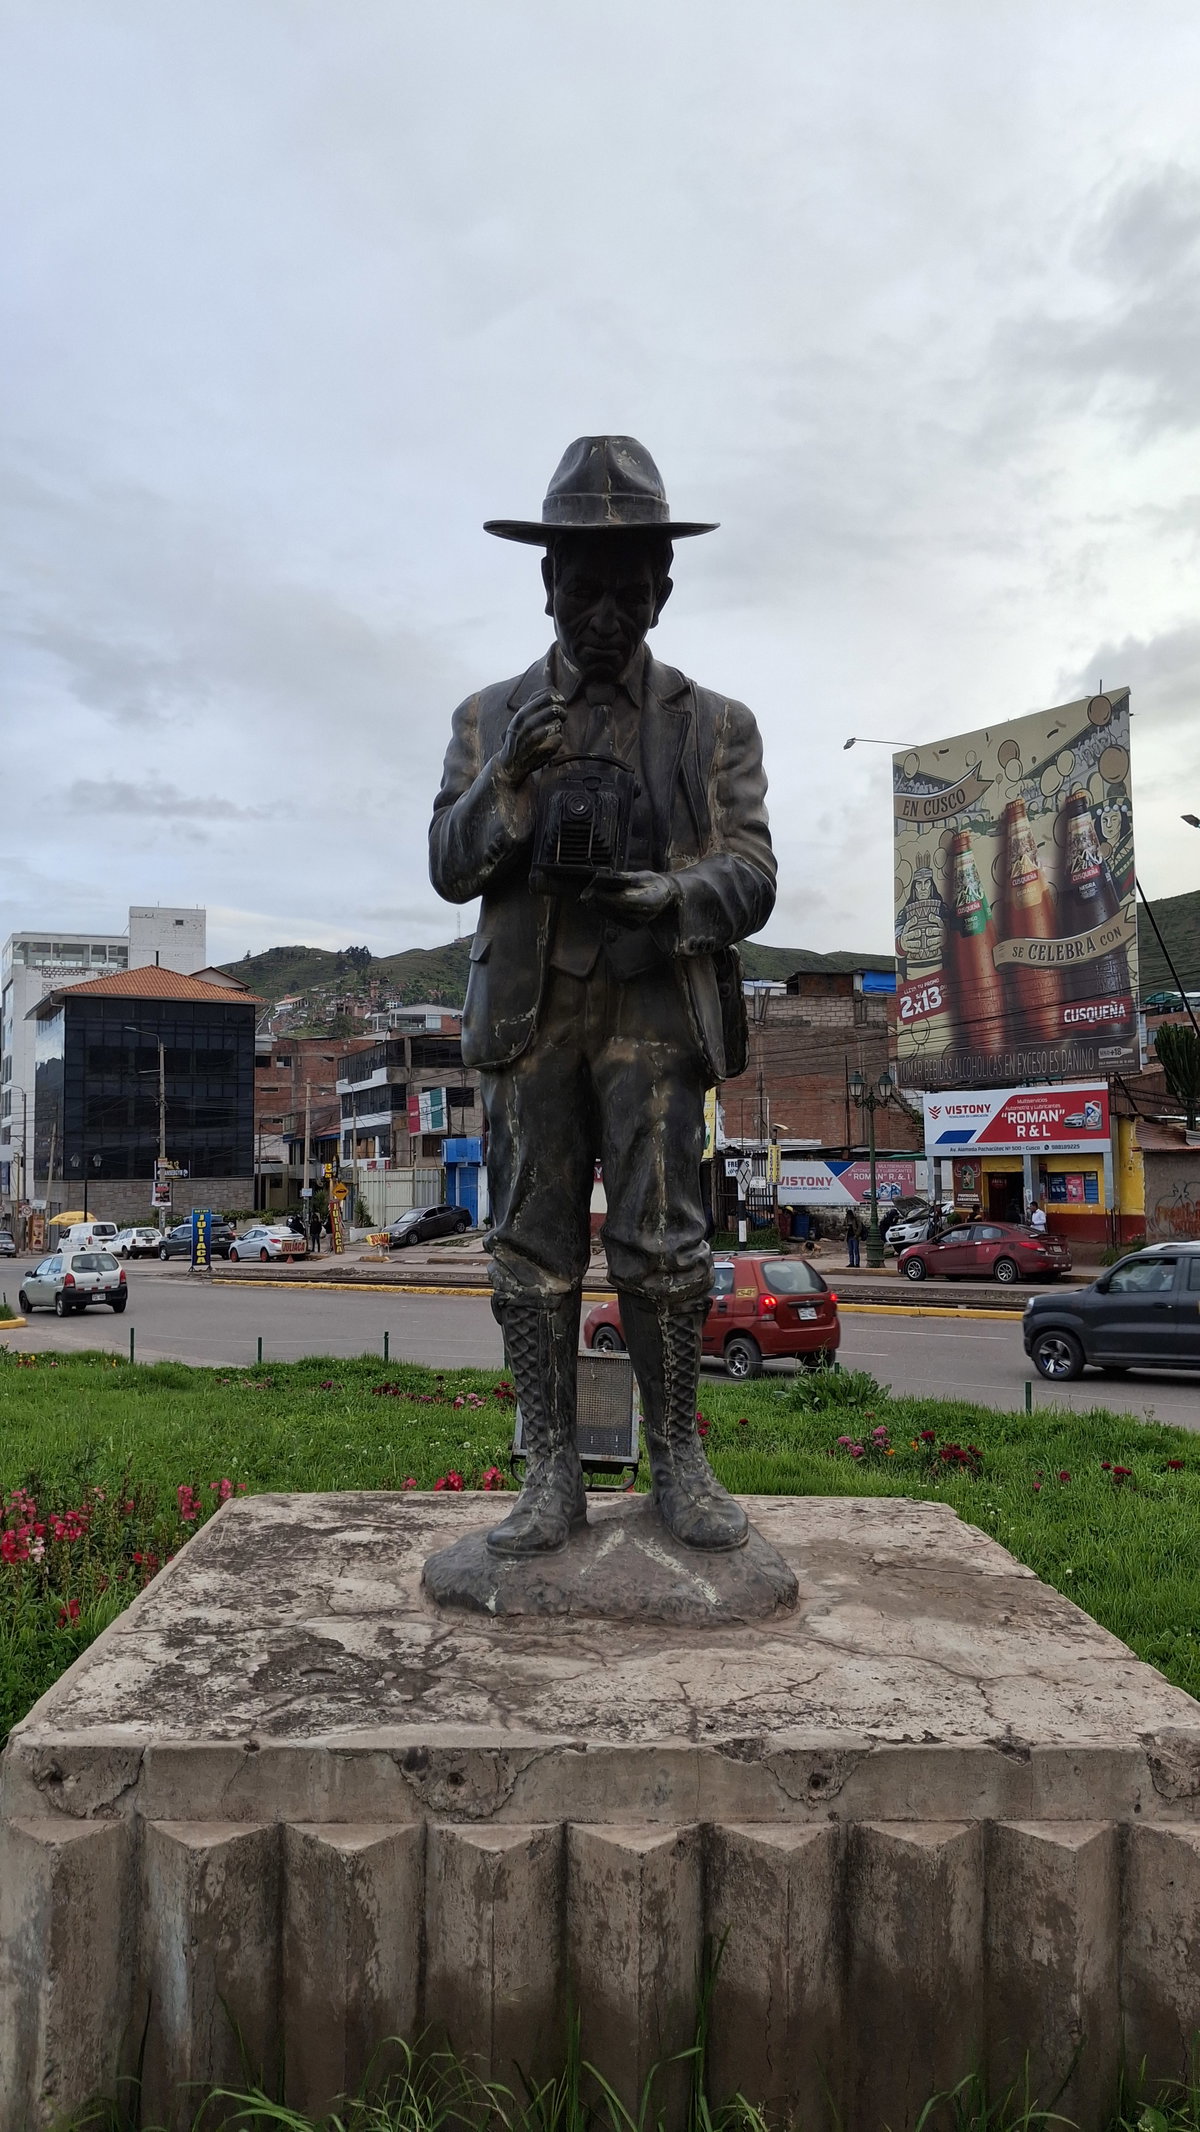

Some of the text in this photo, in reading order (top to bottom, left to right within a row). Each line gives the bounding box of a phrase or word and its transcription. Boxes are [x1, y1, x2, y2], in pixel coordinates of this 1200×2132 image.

[903, 788, 966, 817] EN CUSCO
[1012, 926, 1122, 961] SE CELEBRA CON
[1064, 1001, 1126, 1023] CUSQUEÑA
[900, 1061, 922, 1081] TOMAR
[925, 1059, 952, 1080] BEBIDAS
[1005, 1054, 1015, 1076] EN
[1018, 1051, 1047, 1075] EXCESO
[1049, 1050, 1059, 1073] ES
[1061, 1042, 1095, 1072] DAÑINO
[945, 1104, 991, 1115] VISTONY
[1017, 1124, 1051, 1137] R & L
[197, 1215, 206, 1264] JULIACA
[332, 1203, 342, 1253] JULIACA
